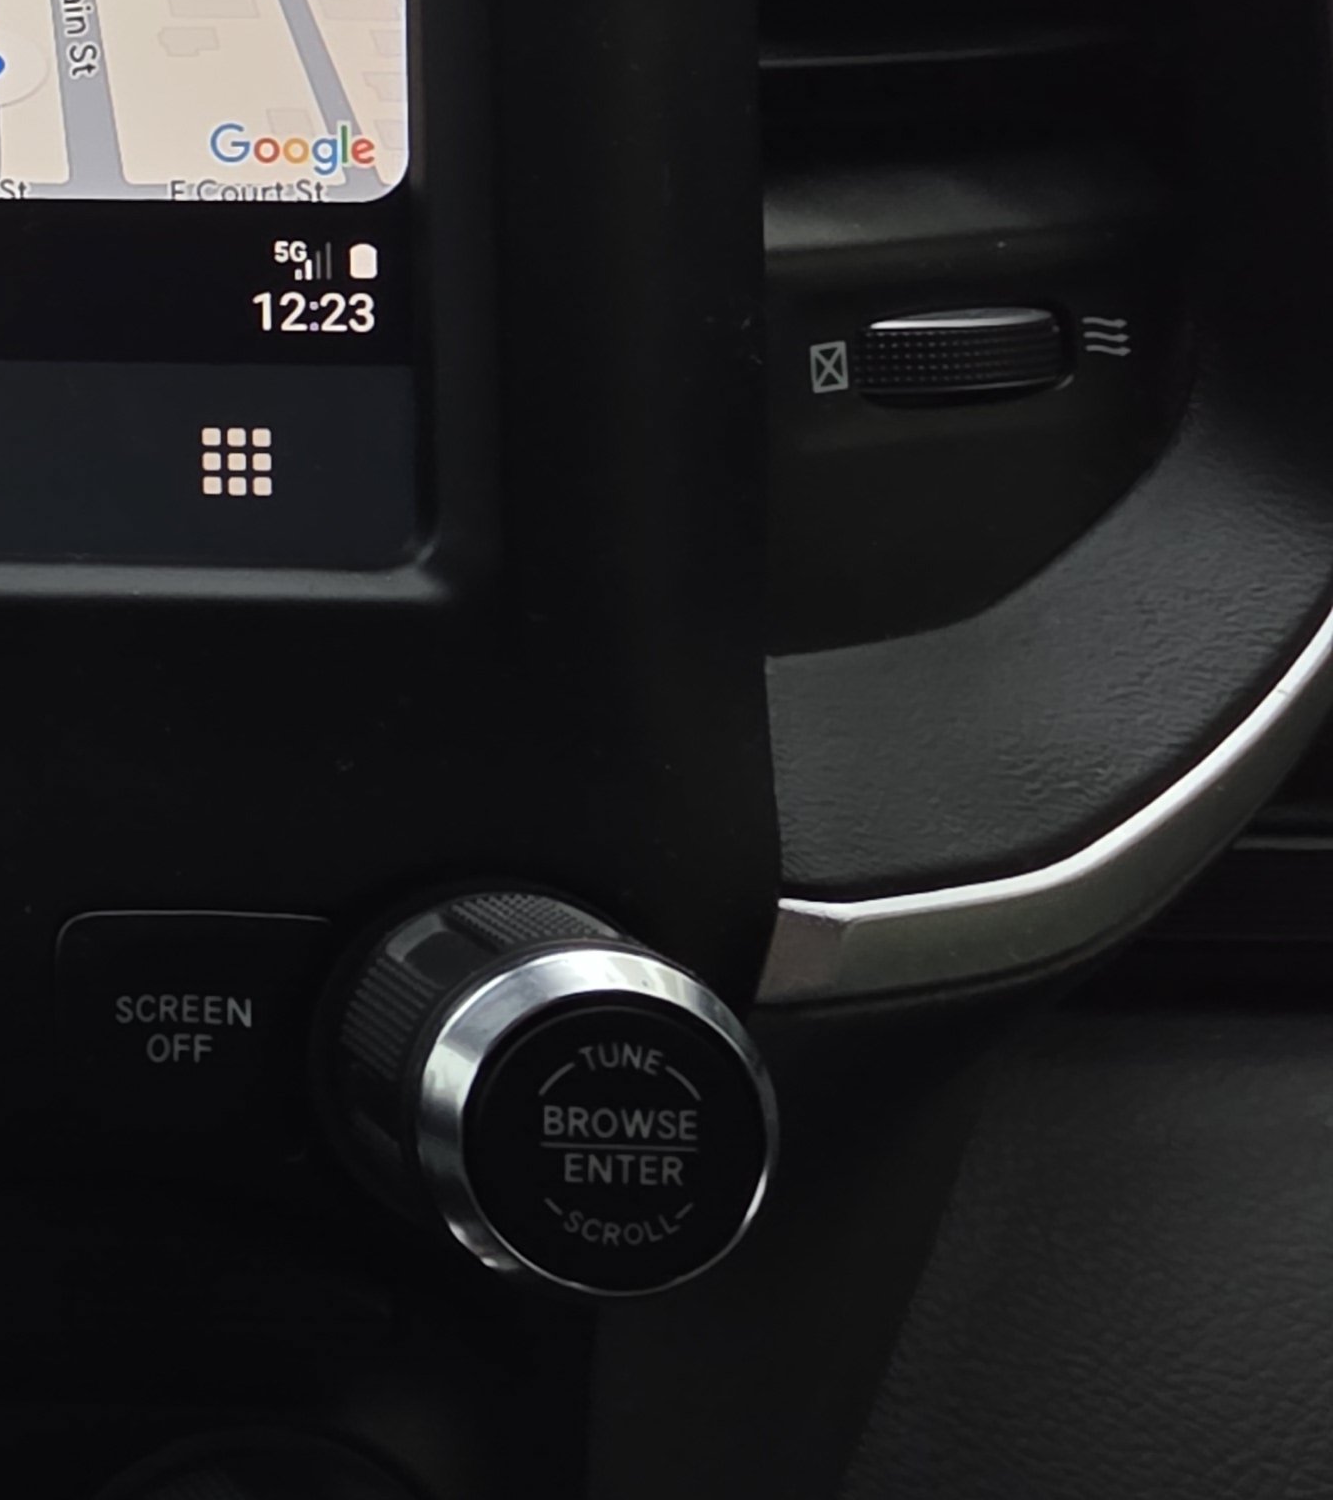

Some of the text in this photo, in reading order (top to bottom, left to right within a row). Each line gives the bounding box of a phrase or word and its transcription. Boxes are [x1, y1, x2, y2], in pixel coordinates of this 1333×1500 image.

[71, 42, 98, 78] St
[210, 123, 375, 175] Google
[0, 179, 27, 199] St
[197, 180, 283, 201] Court
[296, 180, 325, 202] St
[274, 241, 308, 263] 5G
[252, 291, 375, 333] 12:23
[115, 994, 253, 1028] SCREEN
[147, 1034, 213, 1063] OFF
[578, 1042, 664, 1076] TUNE
[542, 1105, 699, 1141] BROWSE
[564, 1154, 684, 1186] ENTER
[563, 1211, 680, 1247] SCROLL
